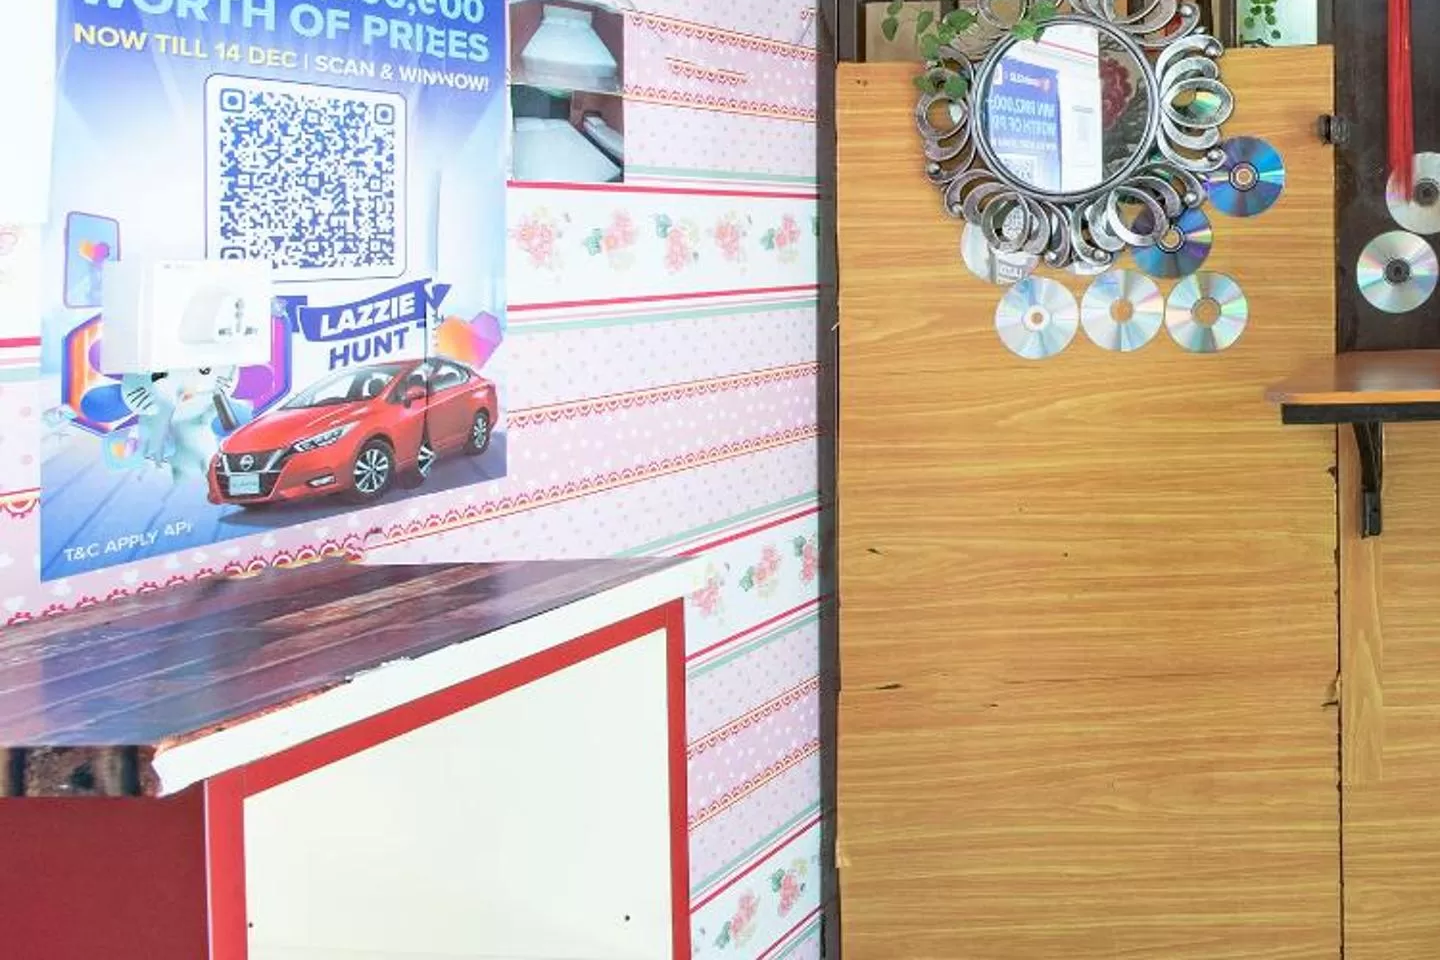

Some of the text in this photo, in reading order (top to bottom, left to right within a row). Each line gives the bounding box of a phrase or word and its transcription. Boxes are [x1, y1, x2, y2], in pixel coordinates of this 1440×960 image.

[290, 2, 350, 39] OF
[73, 22, 148, 51] NOW
[155, 33, 208, 59] TILL
[215, 42, 241, 62] 14
[248, 45, 298, 69] DEC
[315, 54, 375, 78] SCAN
[380, 64, 393, 81] &
[320, 292, 416, 339] LAZZIE
[329, 327, 410, 371] HUNT
[64, 542, 99, 561] T&C
[104, 529, 159, 554] APPLY
